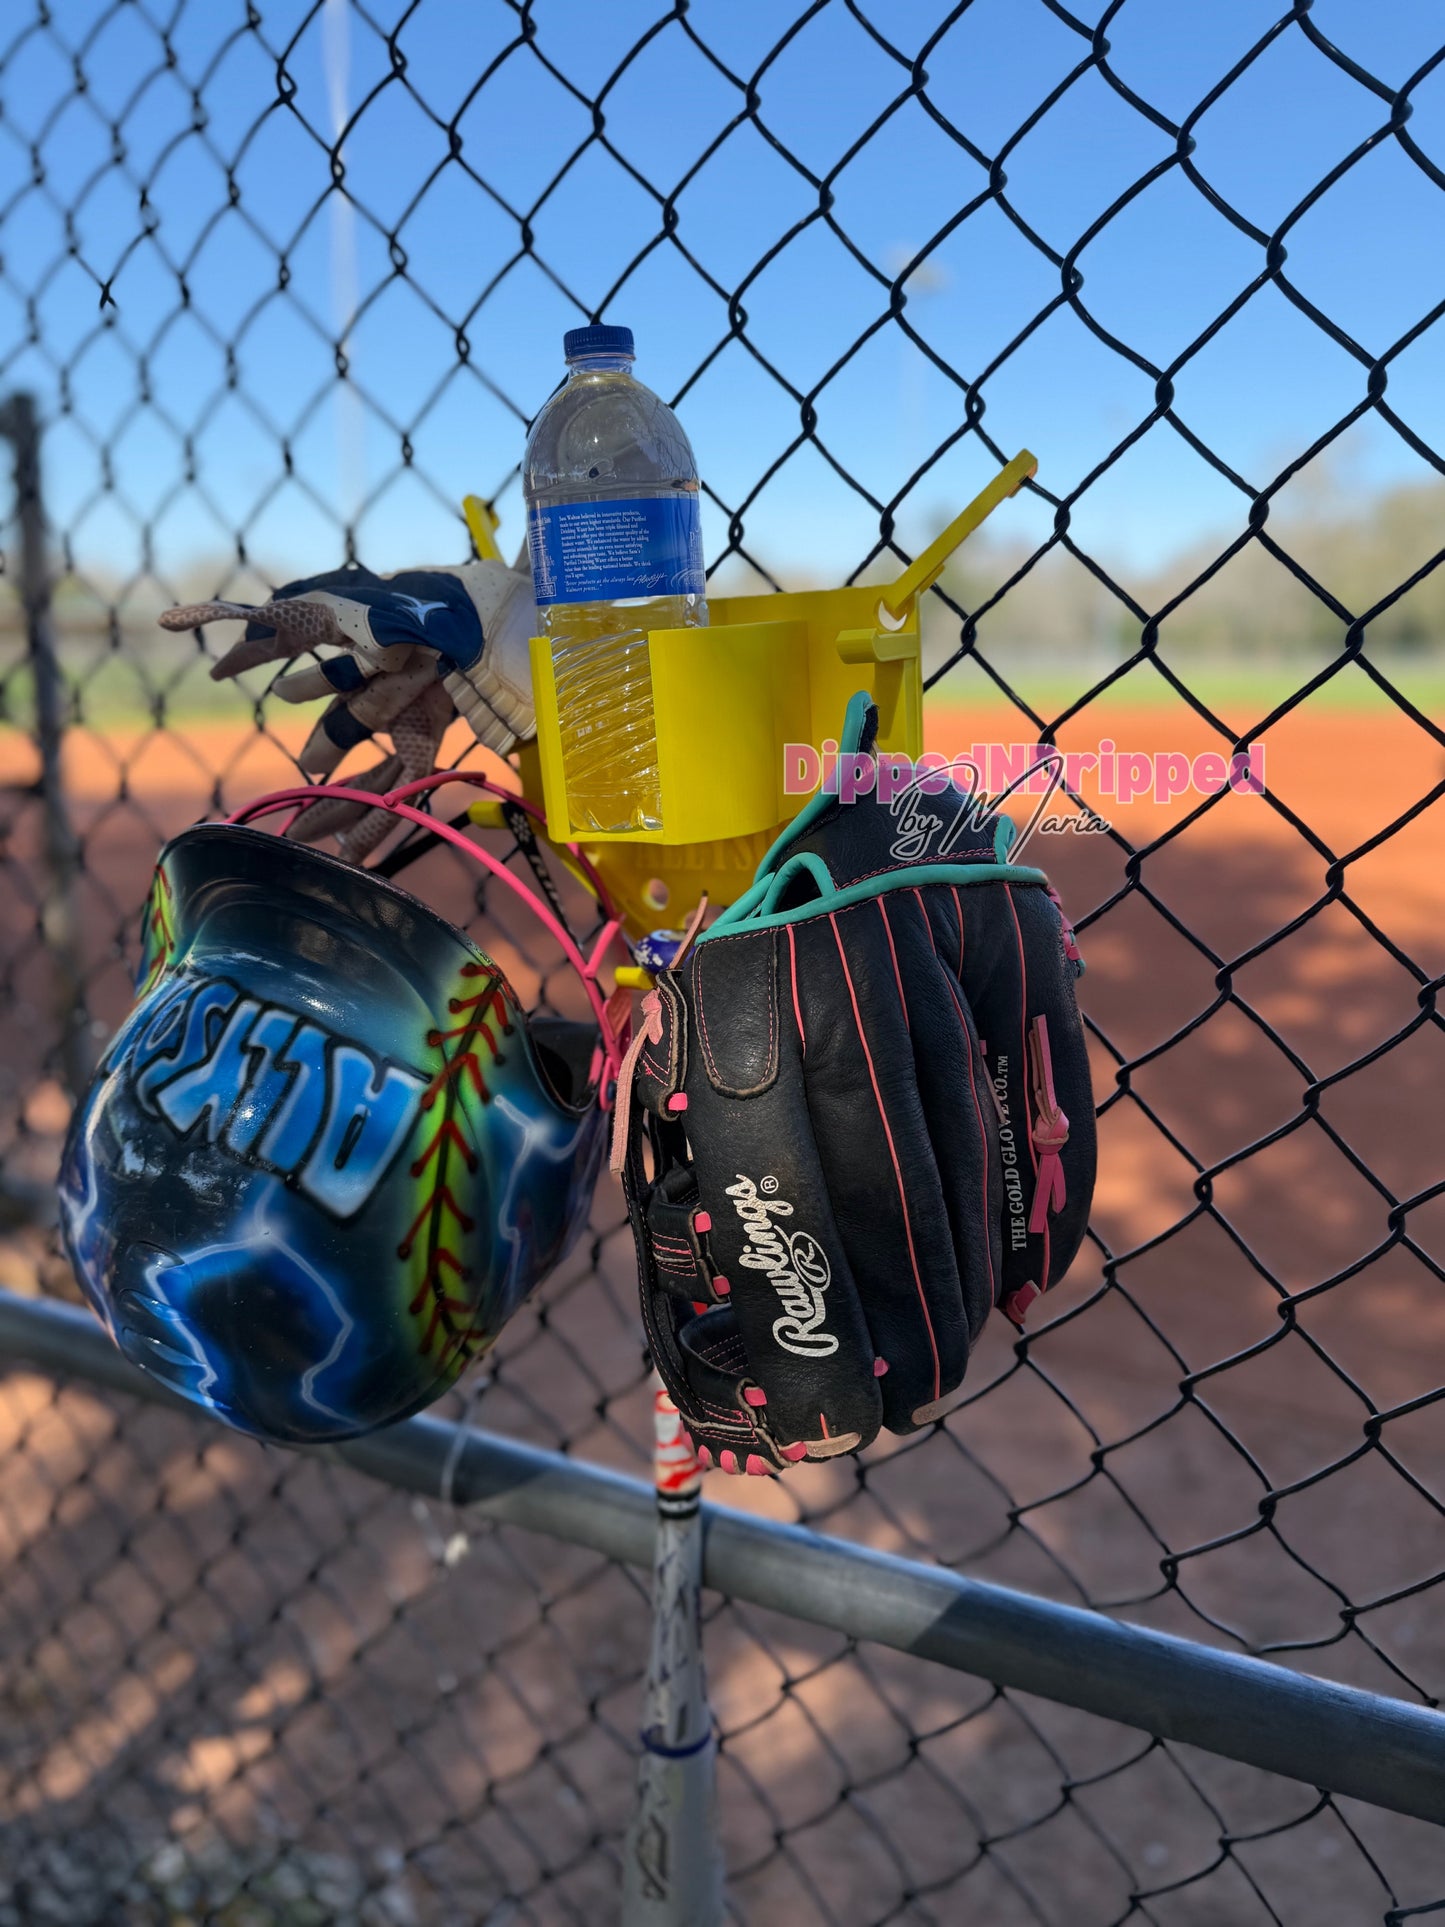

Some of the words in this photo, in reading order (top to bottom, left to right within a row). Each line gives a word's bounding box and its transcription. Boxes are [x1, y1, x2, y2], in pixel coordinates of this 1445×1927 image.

[561, 528, 576, 536] Drinking
[564, 559, 577, 567] Purified
[578, 557, 595, 566] Drinking
[1004, 1168, 1024, 1214] GOLD
[1011, 1216, 1028, 1251] THE
[725, 1173, 840, 1358] Rawlings
